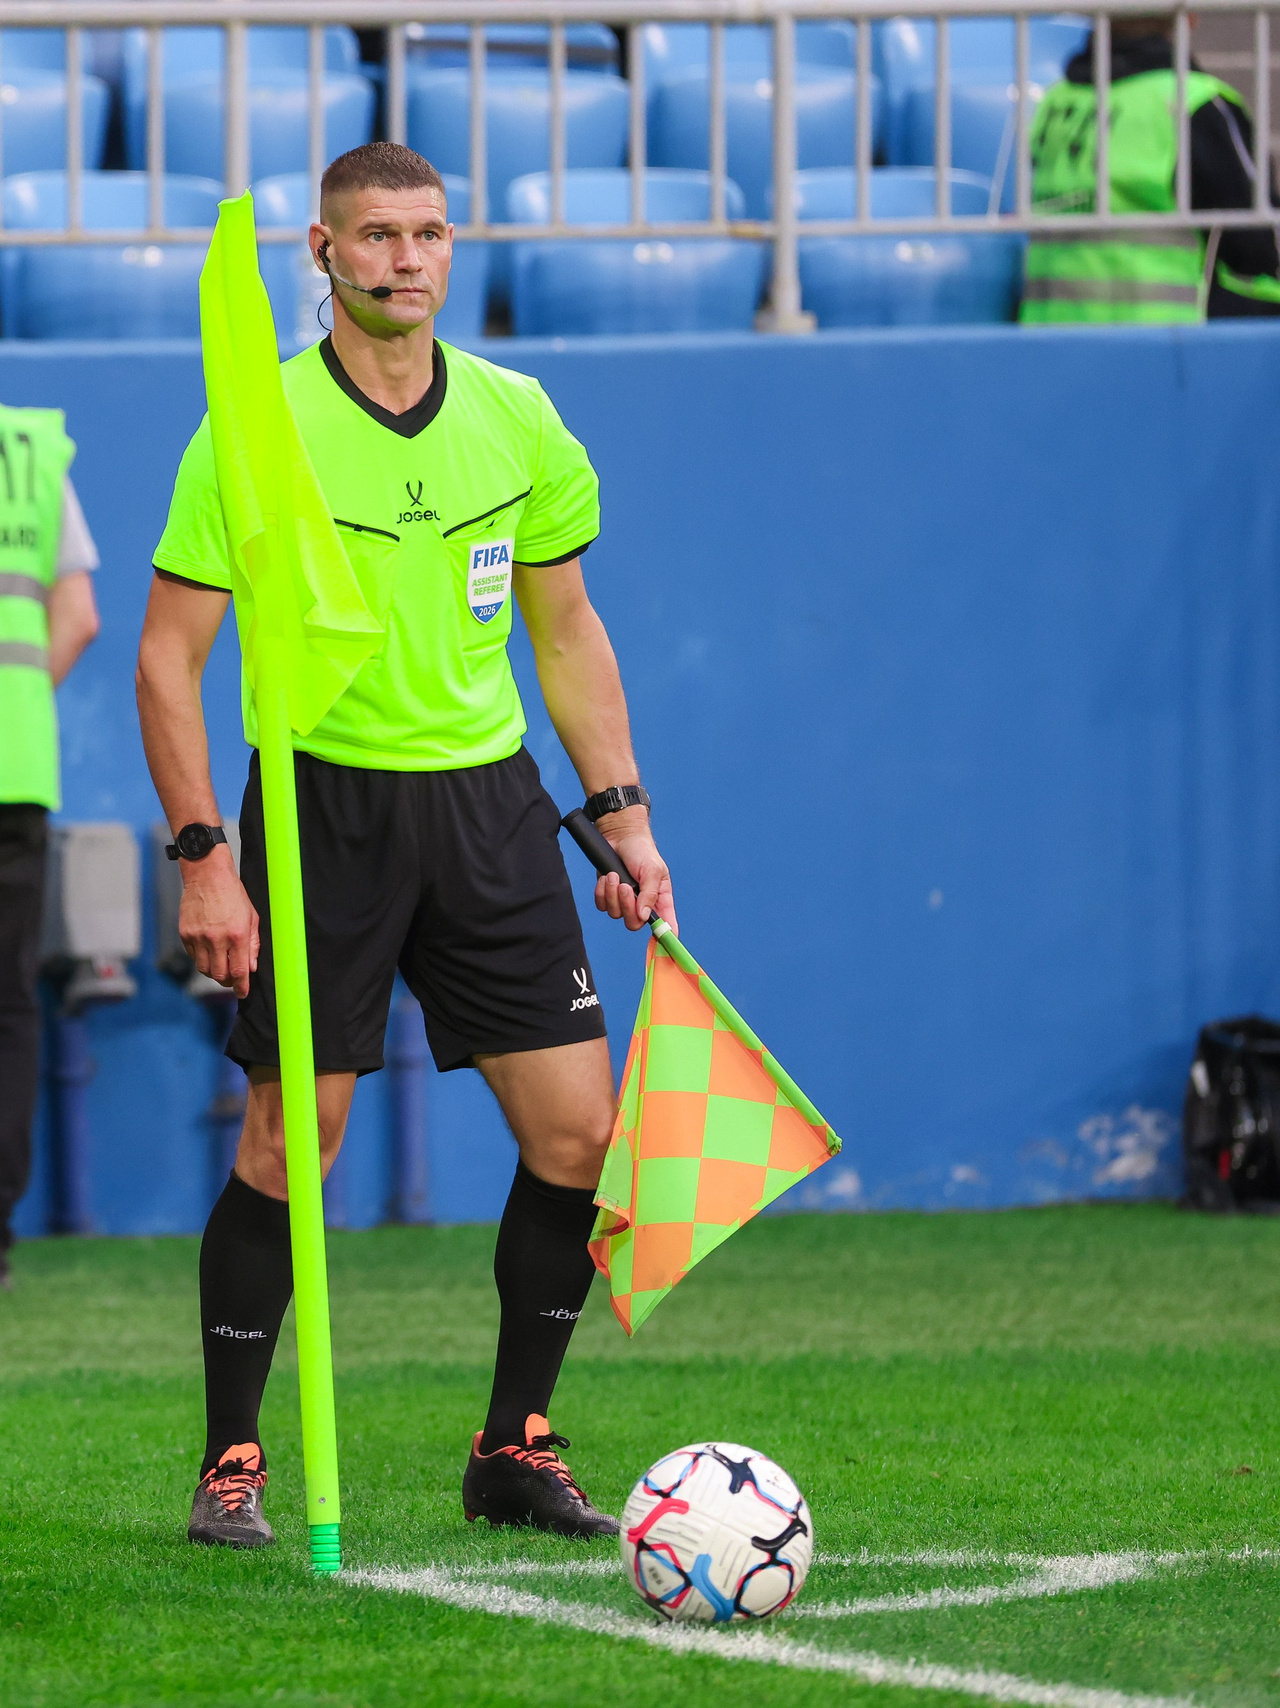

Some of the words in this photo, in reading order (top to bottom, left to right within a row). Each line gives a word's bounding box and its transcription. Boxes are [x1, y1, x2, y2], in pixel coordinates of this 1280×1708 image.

[473, 544, 509, 569] FIFA
[472, 573, 508, 587] ASSISTANT
[474, 583, 505, 596] REFEREE
